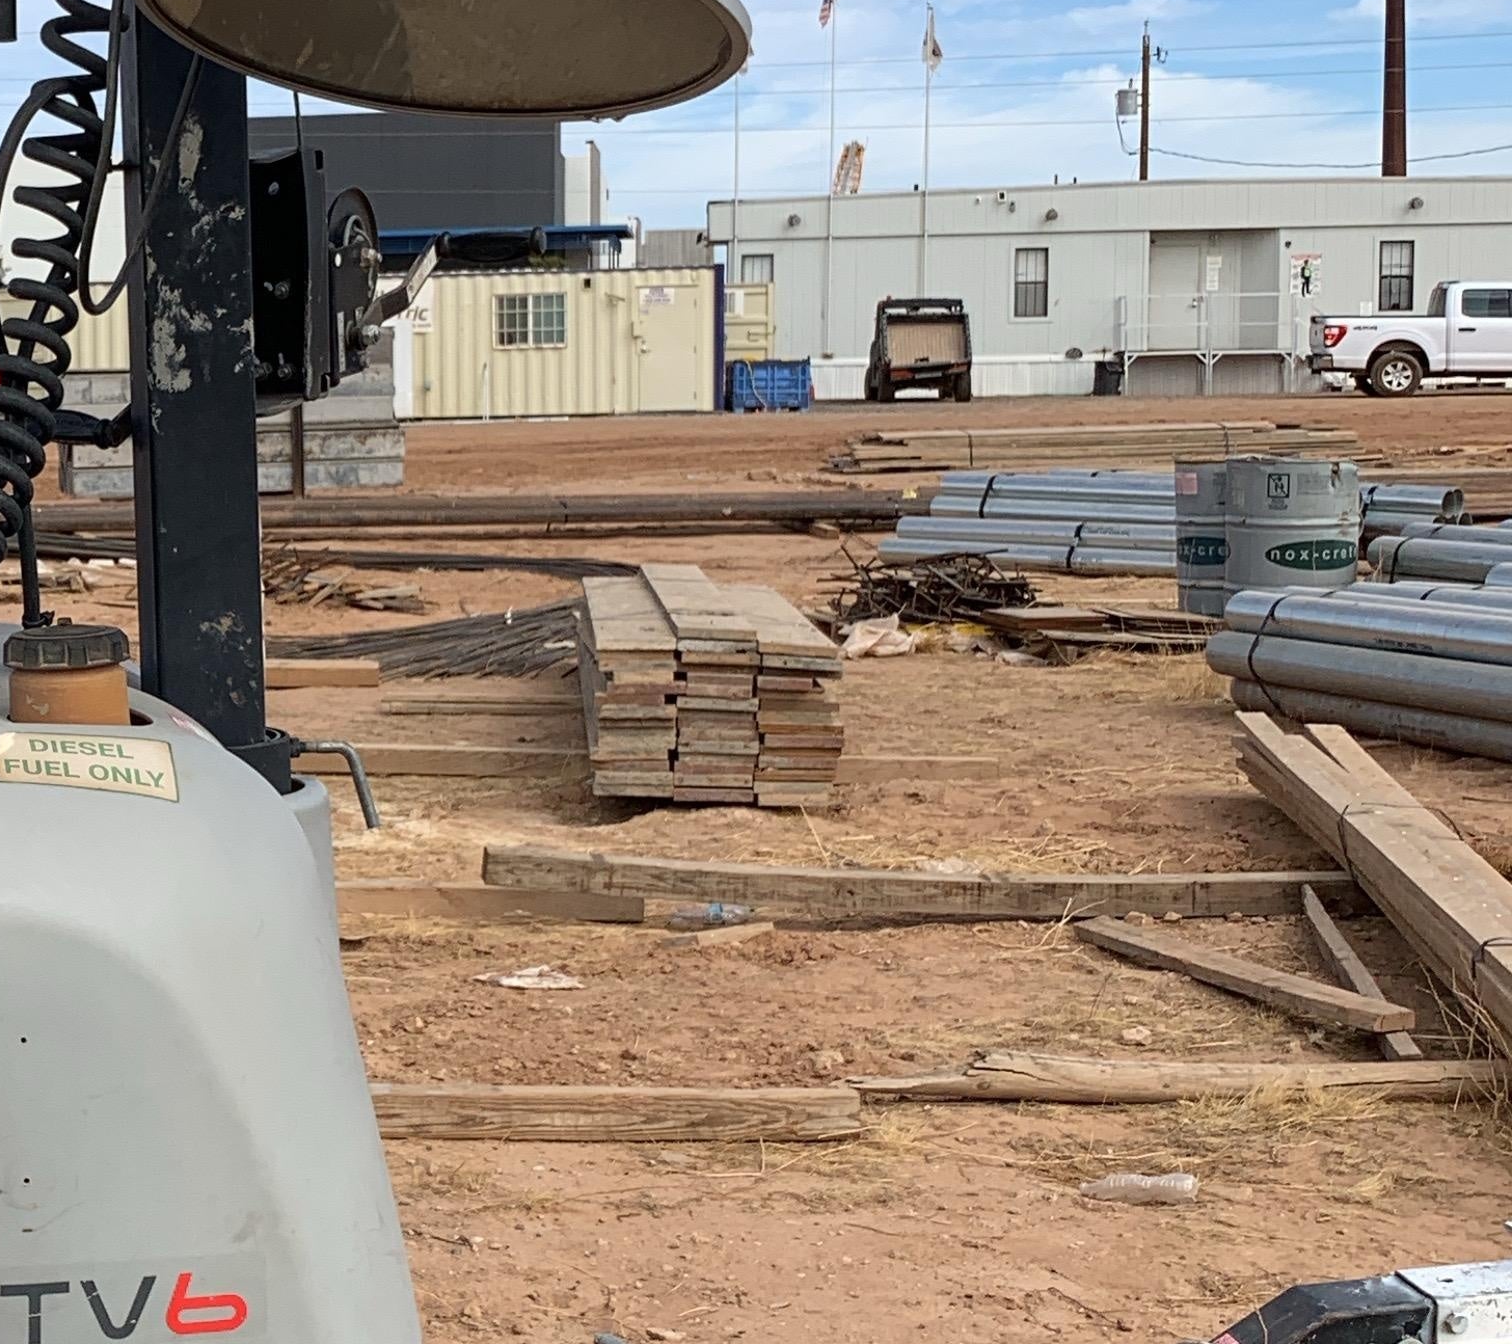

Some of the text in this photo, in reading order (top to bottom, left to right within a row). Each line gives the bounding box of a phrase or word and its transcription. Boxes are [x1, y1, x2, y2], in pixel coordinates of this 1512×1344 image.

[29, 738, 135, 760] DIESEL
[4, 758, 165, 788] FUEL ONLY
